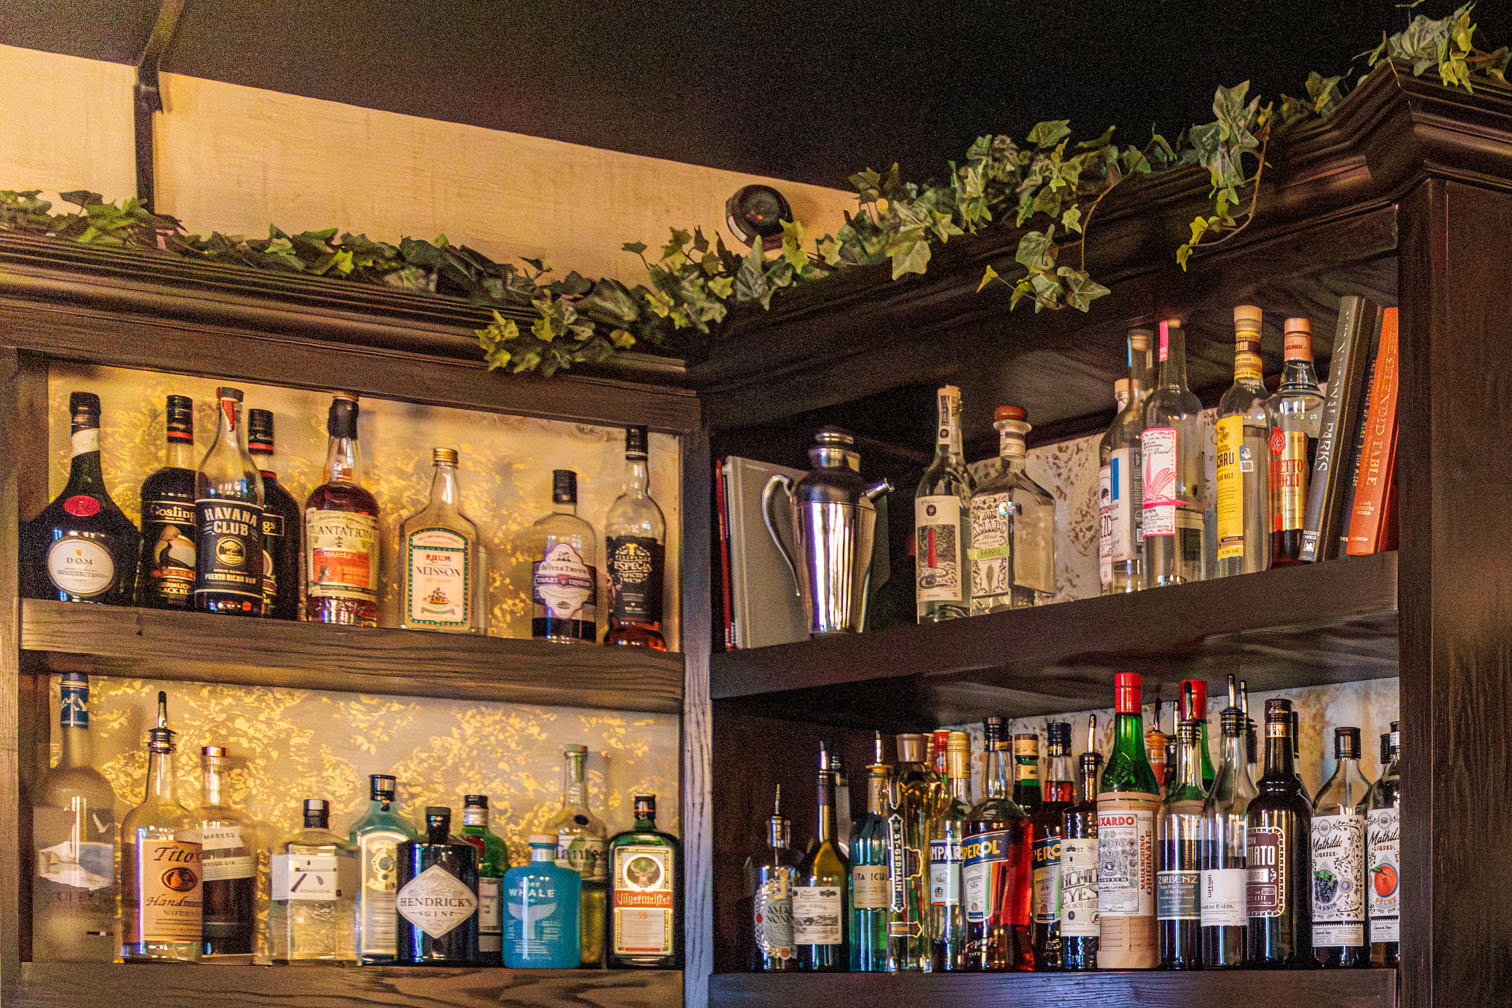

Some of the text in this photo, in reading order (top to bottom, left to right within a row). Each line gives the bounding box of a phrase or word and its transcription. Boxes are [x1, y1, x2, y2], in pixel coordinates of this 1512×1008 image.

[1375, 357, 1394, 437] SPLENDID
[1316, 421, 1336, 472] PARKS
[1366, 441, 1383, 486] TABLE
[204, 507, 257, 527] HAVANA
[214, 521, 248, 536] CLUB
[425, 554, 451, 563] RHUM
[415, 566, 461, 577] NEISSON
[1312, 835, 1342, 850] Mathilde
[508, 889, 555, 898] WHALE
